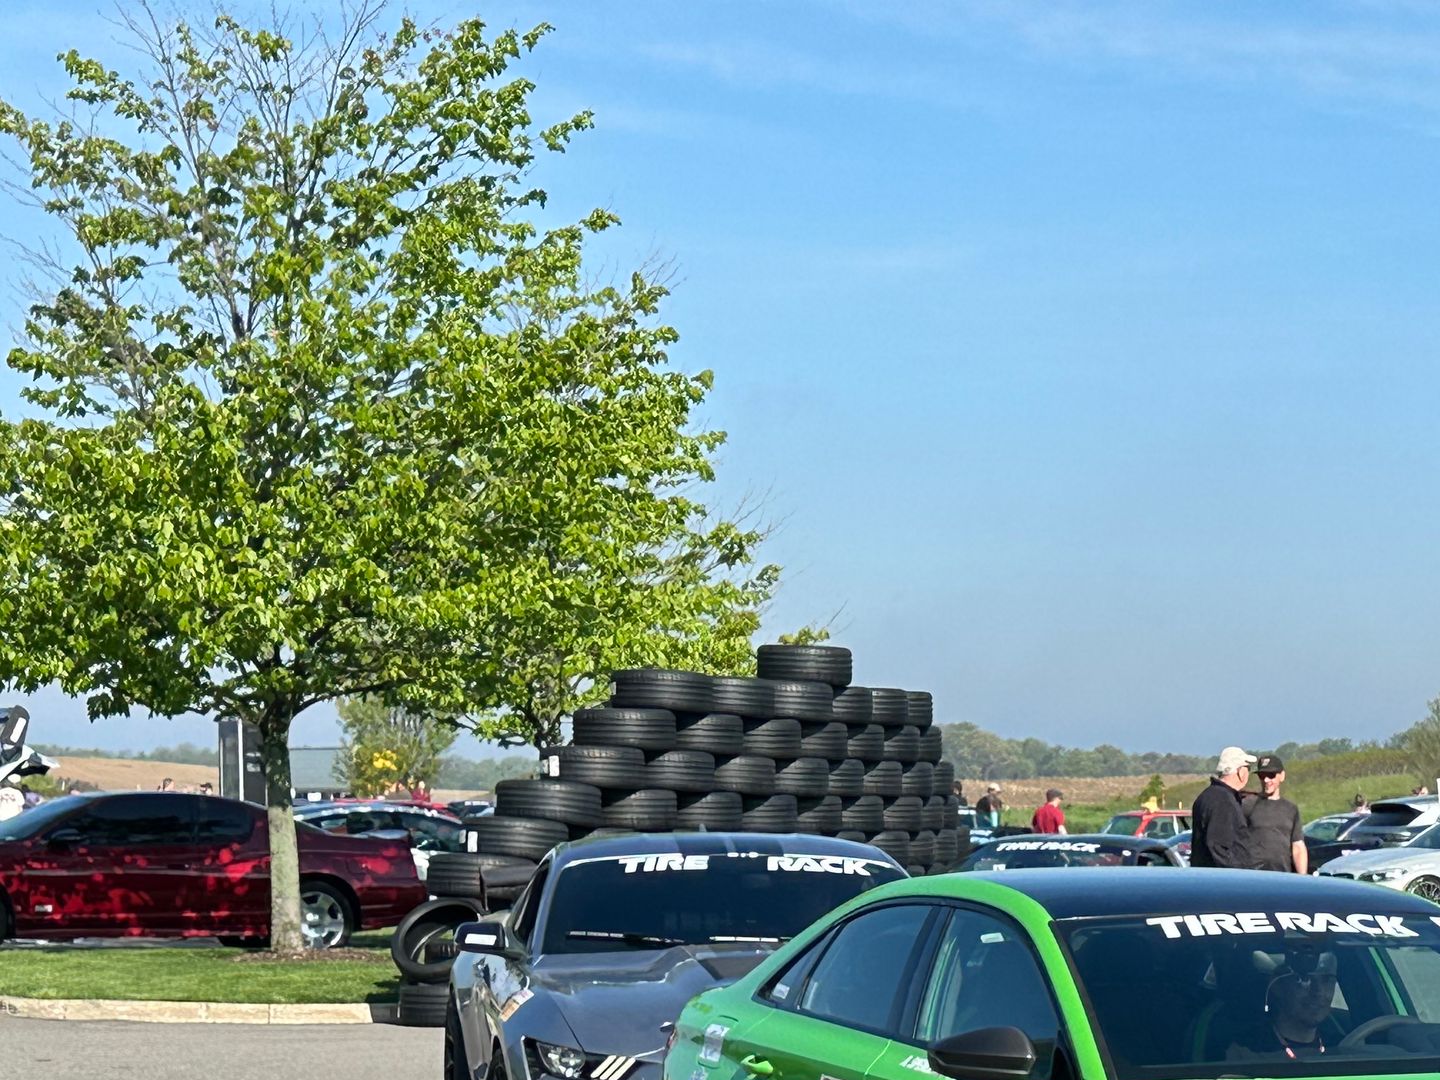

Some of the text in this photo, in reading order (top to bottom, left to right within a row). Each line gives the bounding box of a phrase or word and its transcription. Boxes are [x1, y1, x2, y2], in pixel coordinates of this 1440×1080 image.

[619, 855, 871, 876] TIRE RACK
[1145, 912, 1420, 939] TIRE RACK
